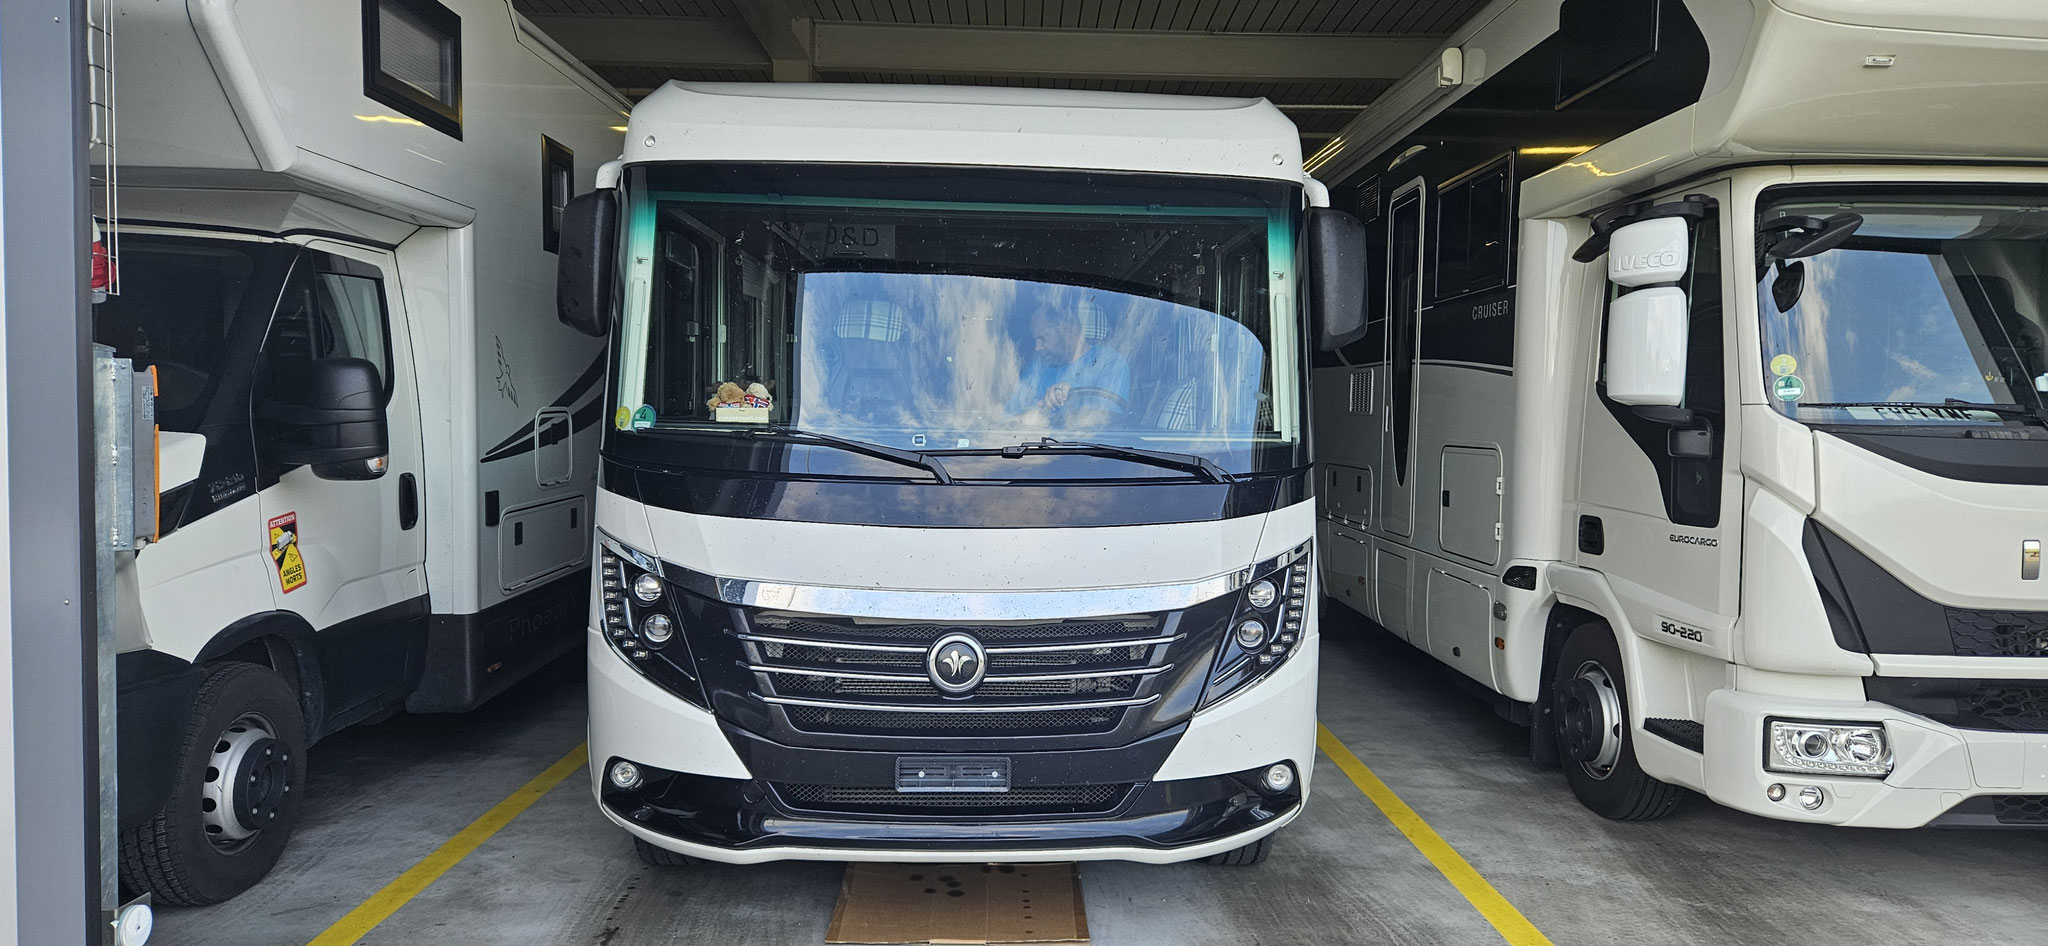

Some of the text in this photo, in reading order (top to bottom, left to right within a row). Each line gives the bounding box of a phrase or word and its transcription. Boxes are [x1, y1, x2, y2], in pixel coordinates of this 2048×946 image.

[1614, 250, 1679, 272] IVECO
[1472, 300, 1509, 320] CRUISER
[1784, 376, 1793, 388] 4
[640, 408, 647, 420] 4
[269, 513, 296, 528] ATTENTION
[1669, 534, 1718, 547] EUROCARGO
[282, 563, 302, 577] ANGLES
[285, 572, 303, 586] MORTS
[1661, 621, 1703, 643] 90-220
